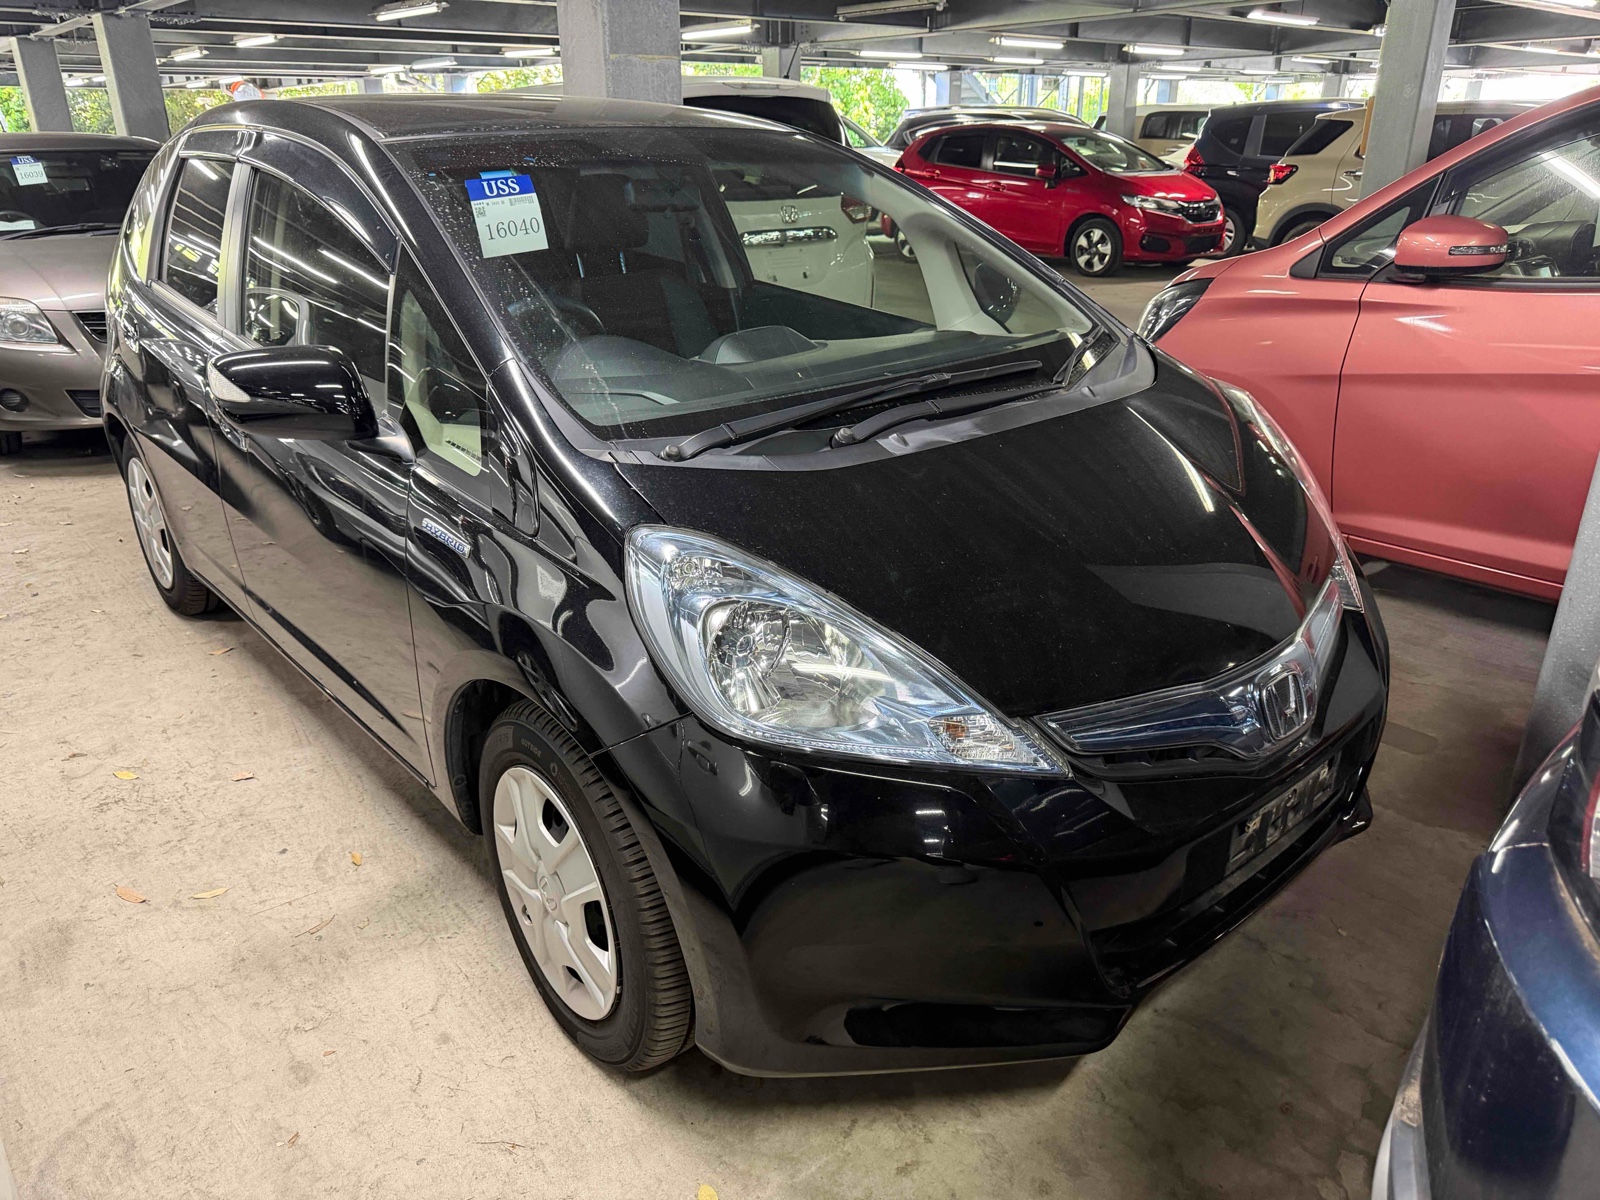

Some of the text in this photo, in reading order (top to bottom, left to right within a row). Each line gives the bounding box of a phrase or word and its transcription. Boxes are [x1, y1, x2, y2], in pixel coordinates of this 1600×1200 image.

[19, 170, 44, 179] 16039
[481, 178, 520, 197] USS
[486, 217, 540, 241] 16040
